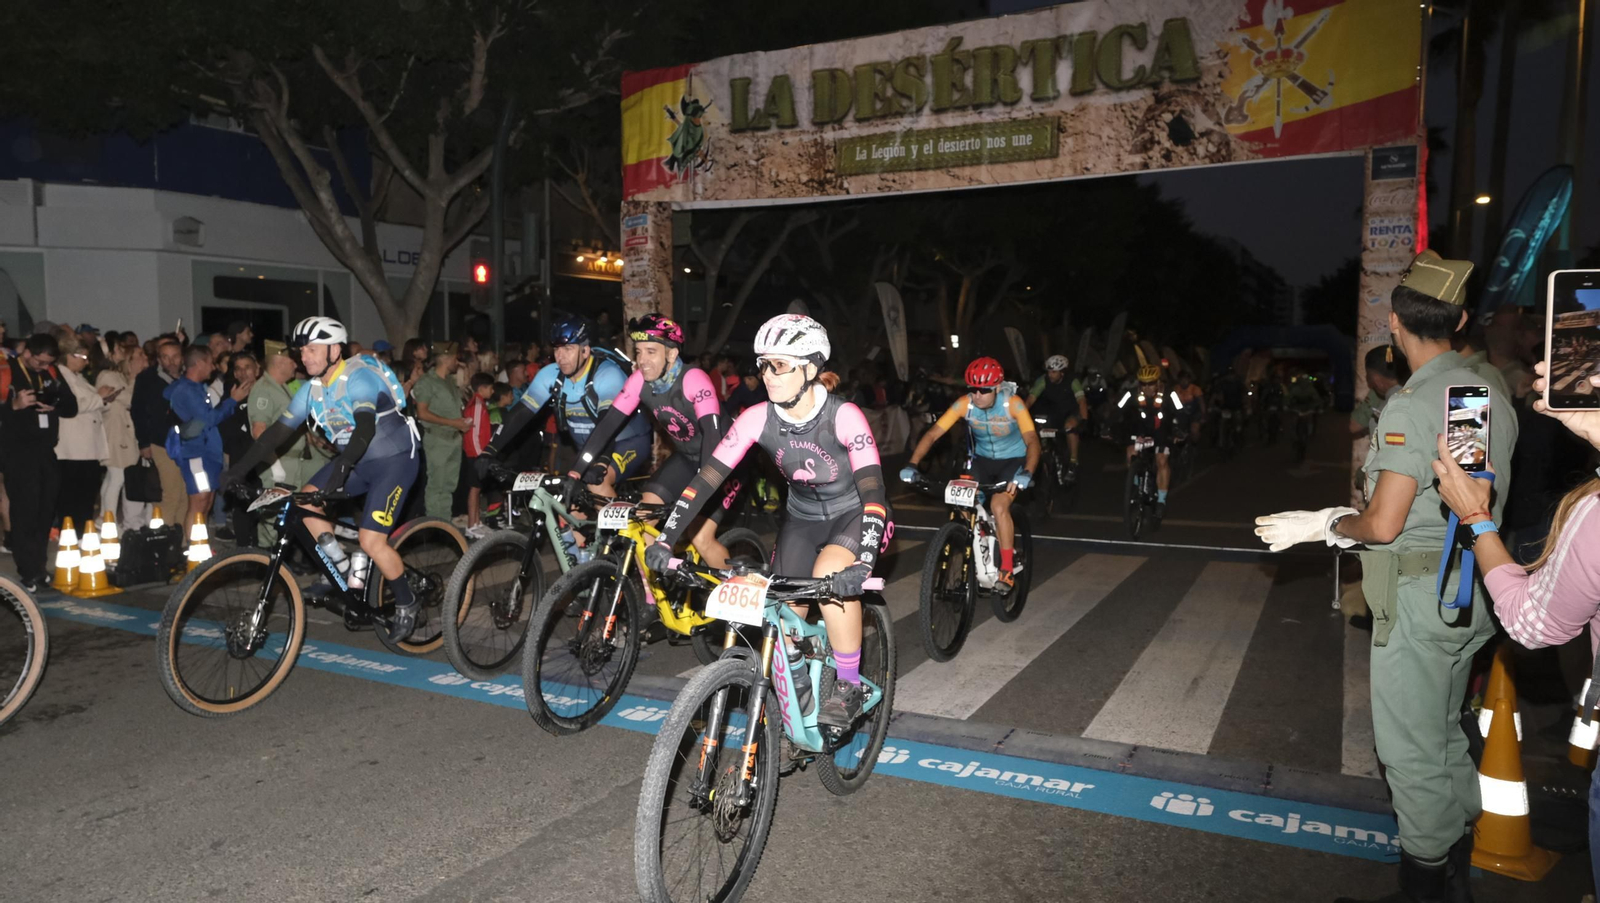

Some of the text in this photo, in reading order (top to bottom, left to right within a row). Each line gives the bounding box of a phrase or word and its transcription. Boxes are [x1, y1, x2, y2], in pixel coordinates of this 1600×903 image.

[729, 16, 1200, 134] LA DESÉRTICA
[855, 134, 1033, 161] La Legión y el desierto nos une
[1369, 225, 1413, 236] RENTA
[789, 440, 835, 465] FLAMENCOS
[847, 432, 874, 453] ego
[950, 486, 974, 499] 6870
[718, 584, 760, 610] 6864
[918, 758, 1096, 794] cajamar
[995, 780, 1083, 800] CAJA RURAL
[1334, 837, 1380, 850] CAJA
